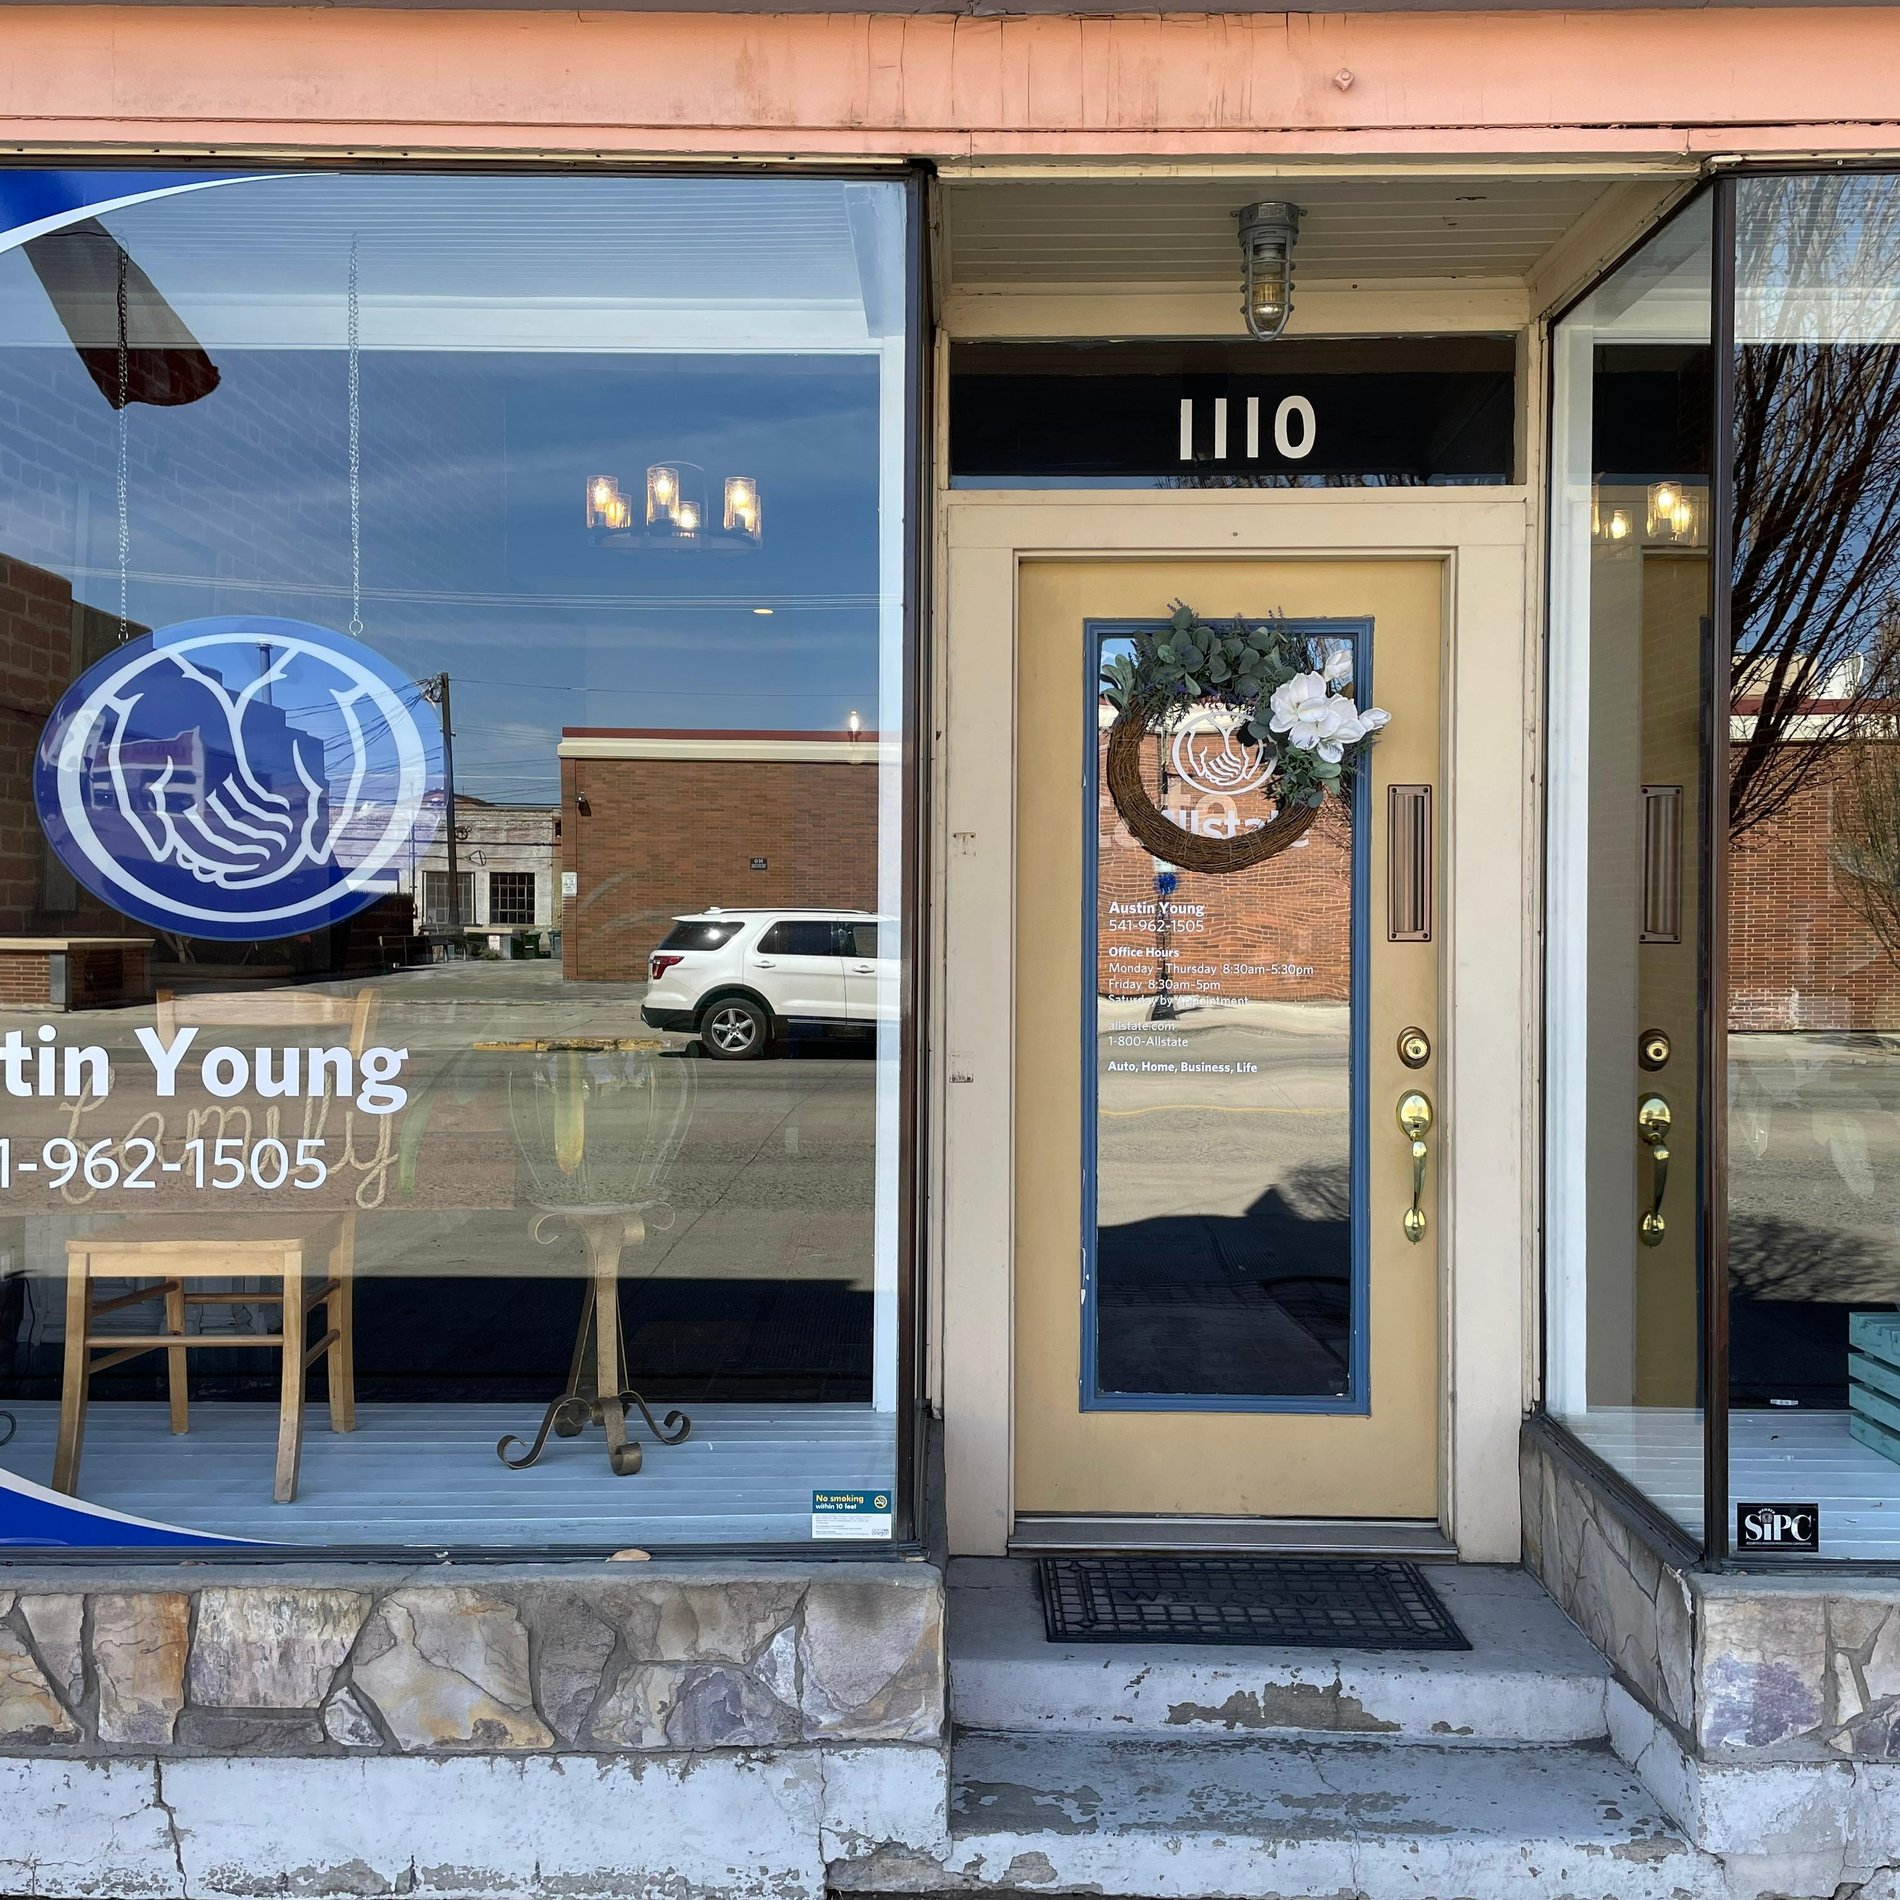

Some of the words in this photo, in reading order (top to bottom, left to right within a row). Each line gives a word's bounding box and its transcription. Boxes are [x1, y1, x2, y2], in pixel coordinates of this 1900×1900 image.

[1180, 395, 1316, 460] 1110
[1108, 901, 1156, 914] Austin
[1158, 901, 1205, 917] Young
[1108, 919, 1204, 933] 541-962-1505
[1108, 947, 1143, 958] Office
[1145, 947, 1180, 958] Hours
[1108, 962, 1154, 975] Monday
[1165, 962, 1217, 976] Thursday
[1108, 979, 1142, 991] Friday
[1108, 994, 1158, 1007] Saturday
[1160, 995, 1173, 1008] by
[1108, 1020, 1175, 1031] allstate.com
[1107, 1035, 1189, 1047] 1-800-Allstate
[134, 1026, 409, 1115] Young
[1107, 1060, 1139, 1074] Auto,
[1141, 1061, 1178, 1074] Home,
[1180, 1061, 1234, 1074] Business,
[1236, 1062, 1258, 1074] Life
[816, 1494, 829, 1502] No
[830, 1494, 864, 1504] smoking
